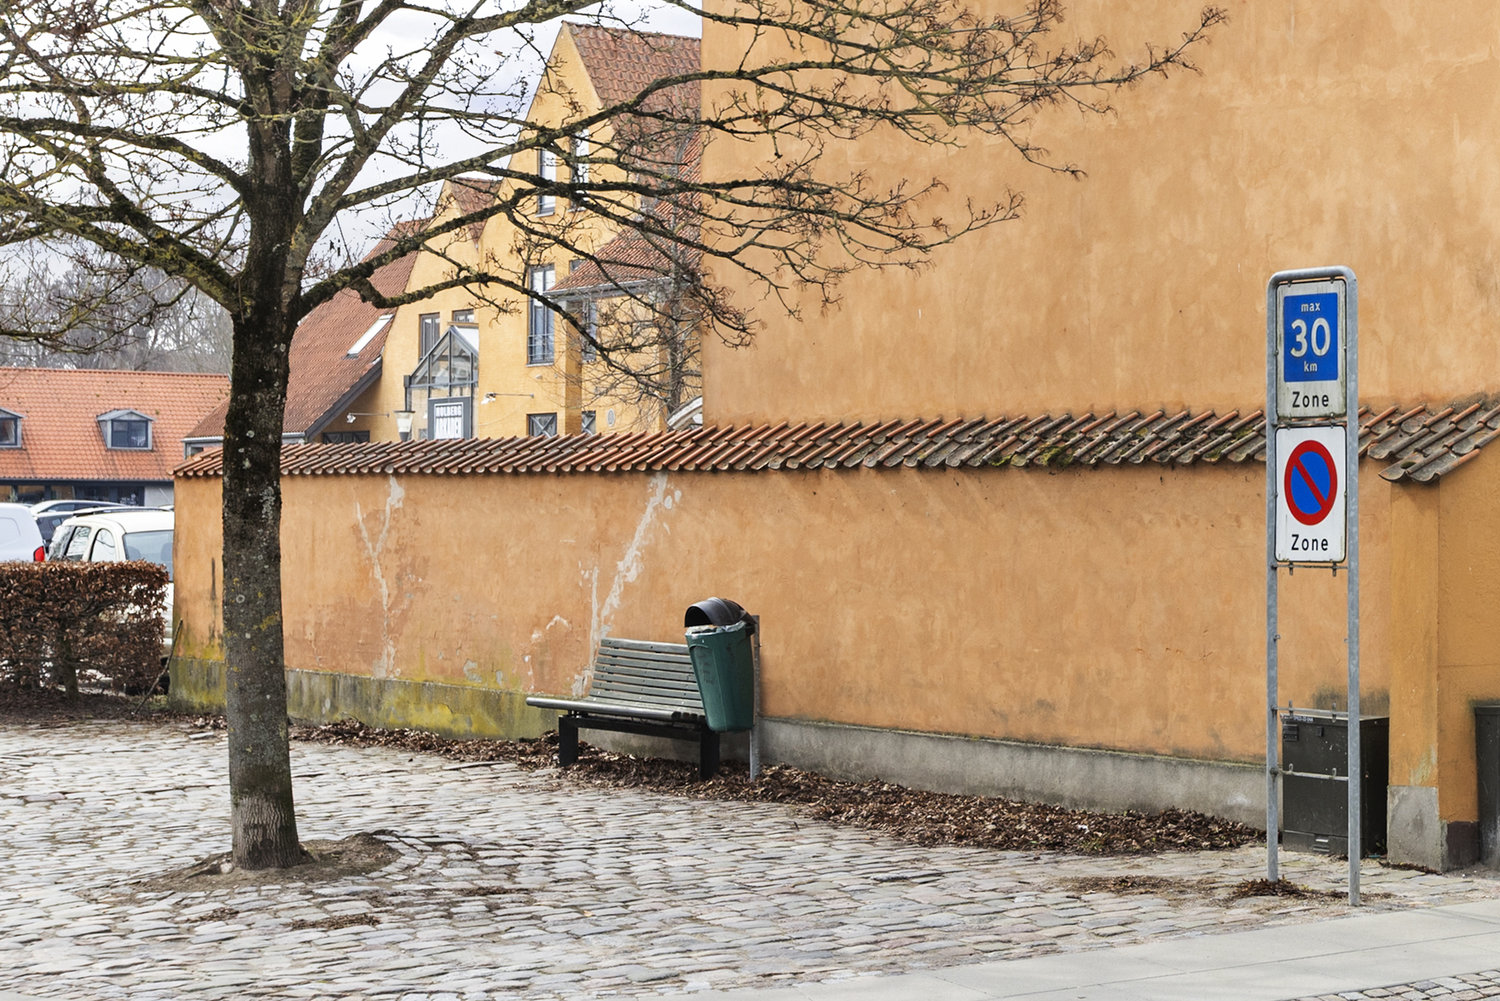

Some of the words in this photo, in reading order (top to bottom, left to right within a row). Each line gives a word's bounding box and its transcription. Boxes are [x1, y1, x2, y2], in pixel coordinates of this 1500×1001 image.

[1301, 302, 1320, 312] max
[1290, 317, 1331, 358] 30
[1303, 360, 1318, 372] km
[1292, 391, 1329, 408] Zone
[1291, 534, 1329, 551] Zone
